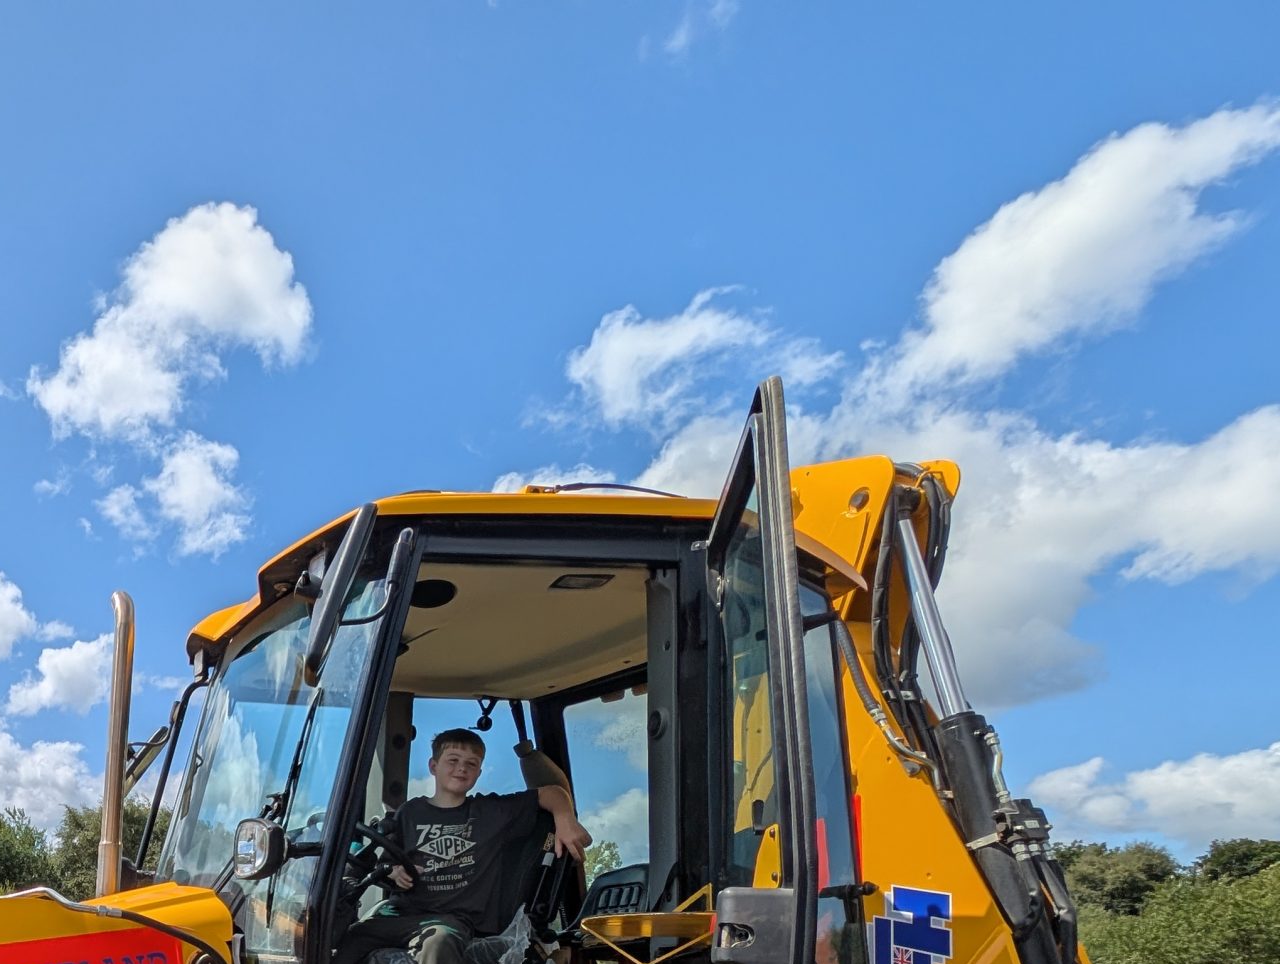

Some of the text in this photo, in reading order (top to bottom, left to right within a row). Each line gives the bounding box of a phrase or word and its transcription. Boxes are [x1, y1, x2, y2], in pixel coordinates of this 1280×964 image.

[416, 824, 442, 846] 75
[429, 838, 466, 856] SUPER
[423, 855, 475, 872] Speedway
[436, 873, 463, 882] EDITION
